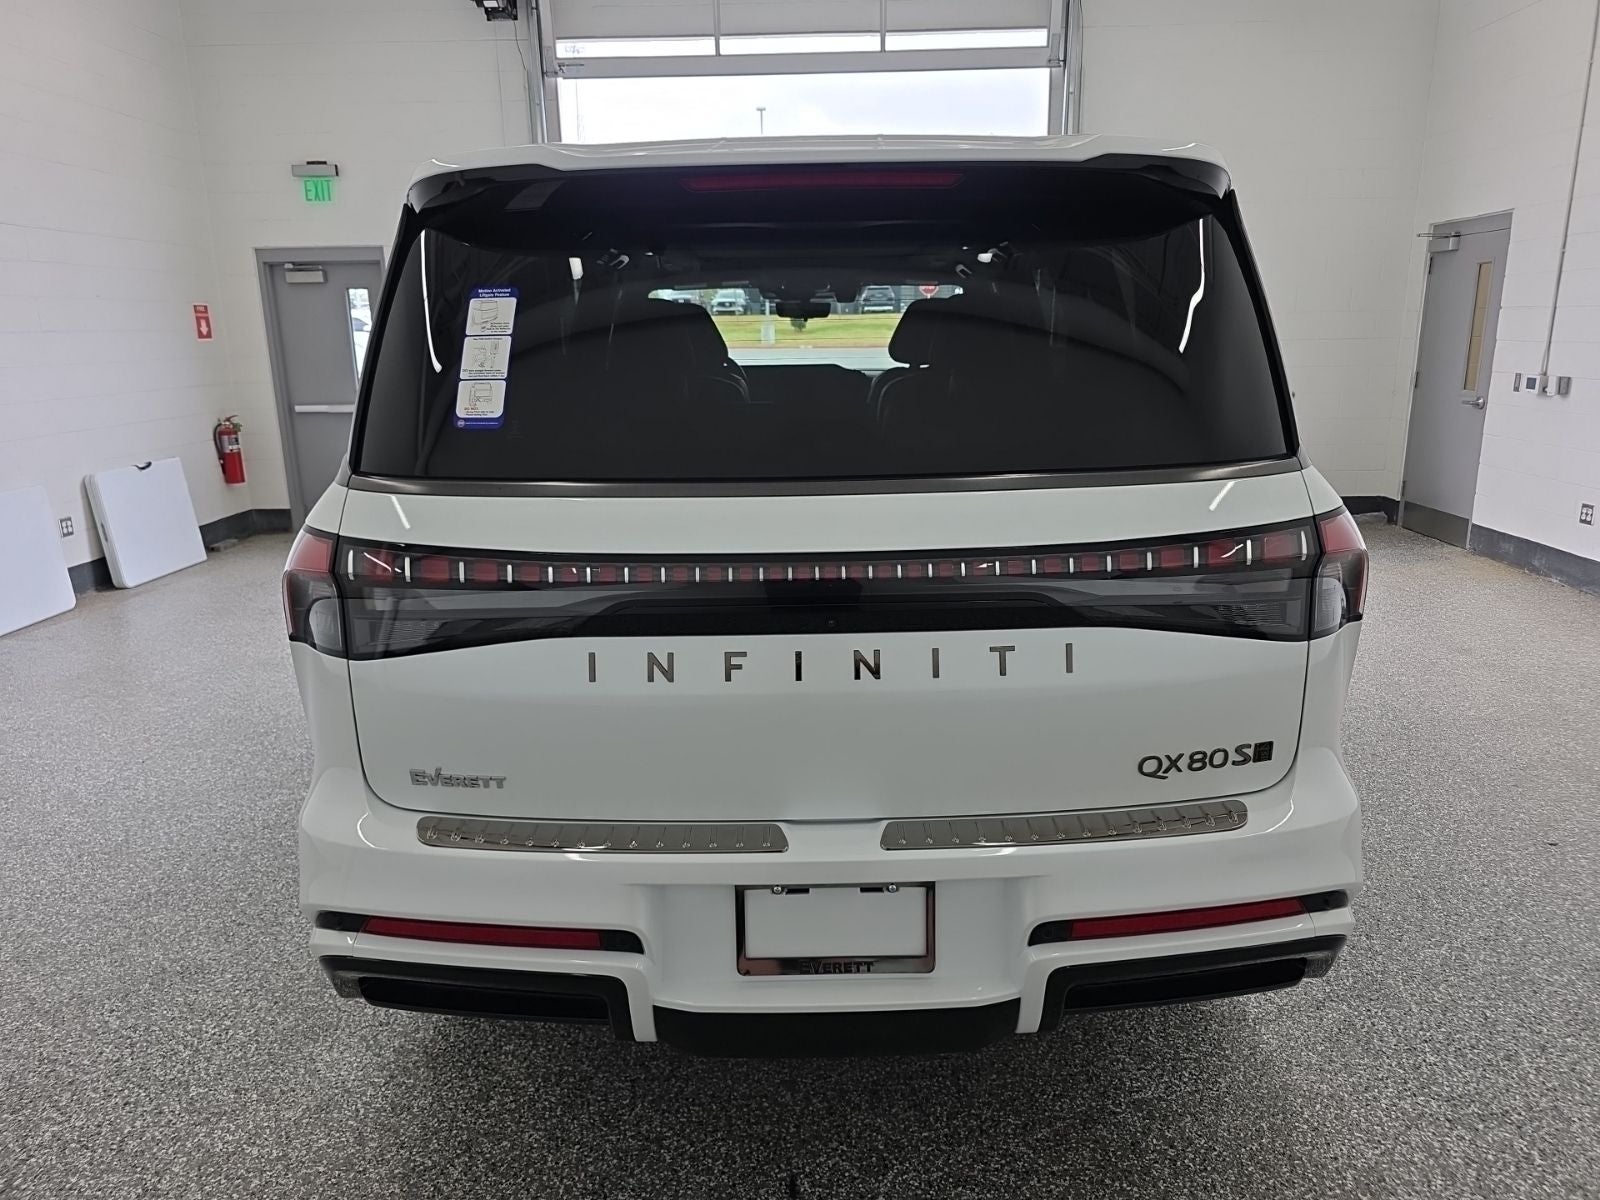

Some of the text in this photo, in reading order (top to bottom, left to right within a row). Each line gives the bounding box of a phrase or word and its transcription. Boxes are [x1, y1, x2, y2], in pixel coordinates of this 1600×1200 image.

[303, 179, 332, 202] EXIT
[588, 642, 1074, 683] INFINITI
[799, 960, 874, 974] EVERETT
